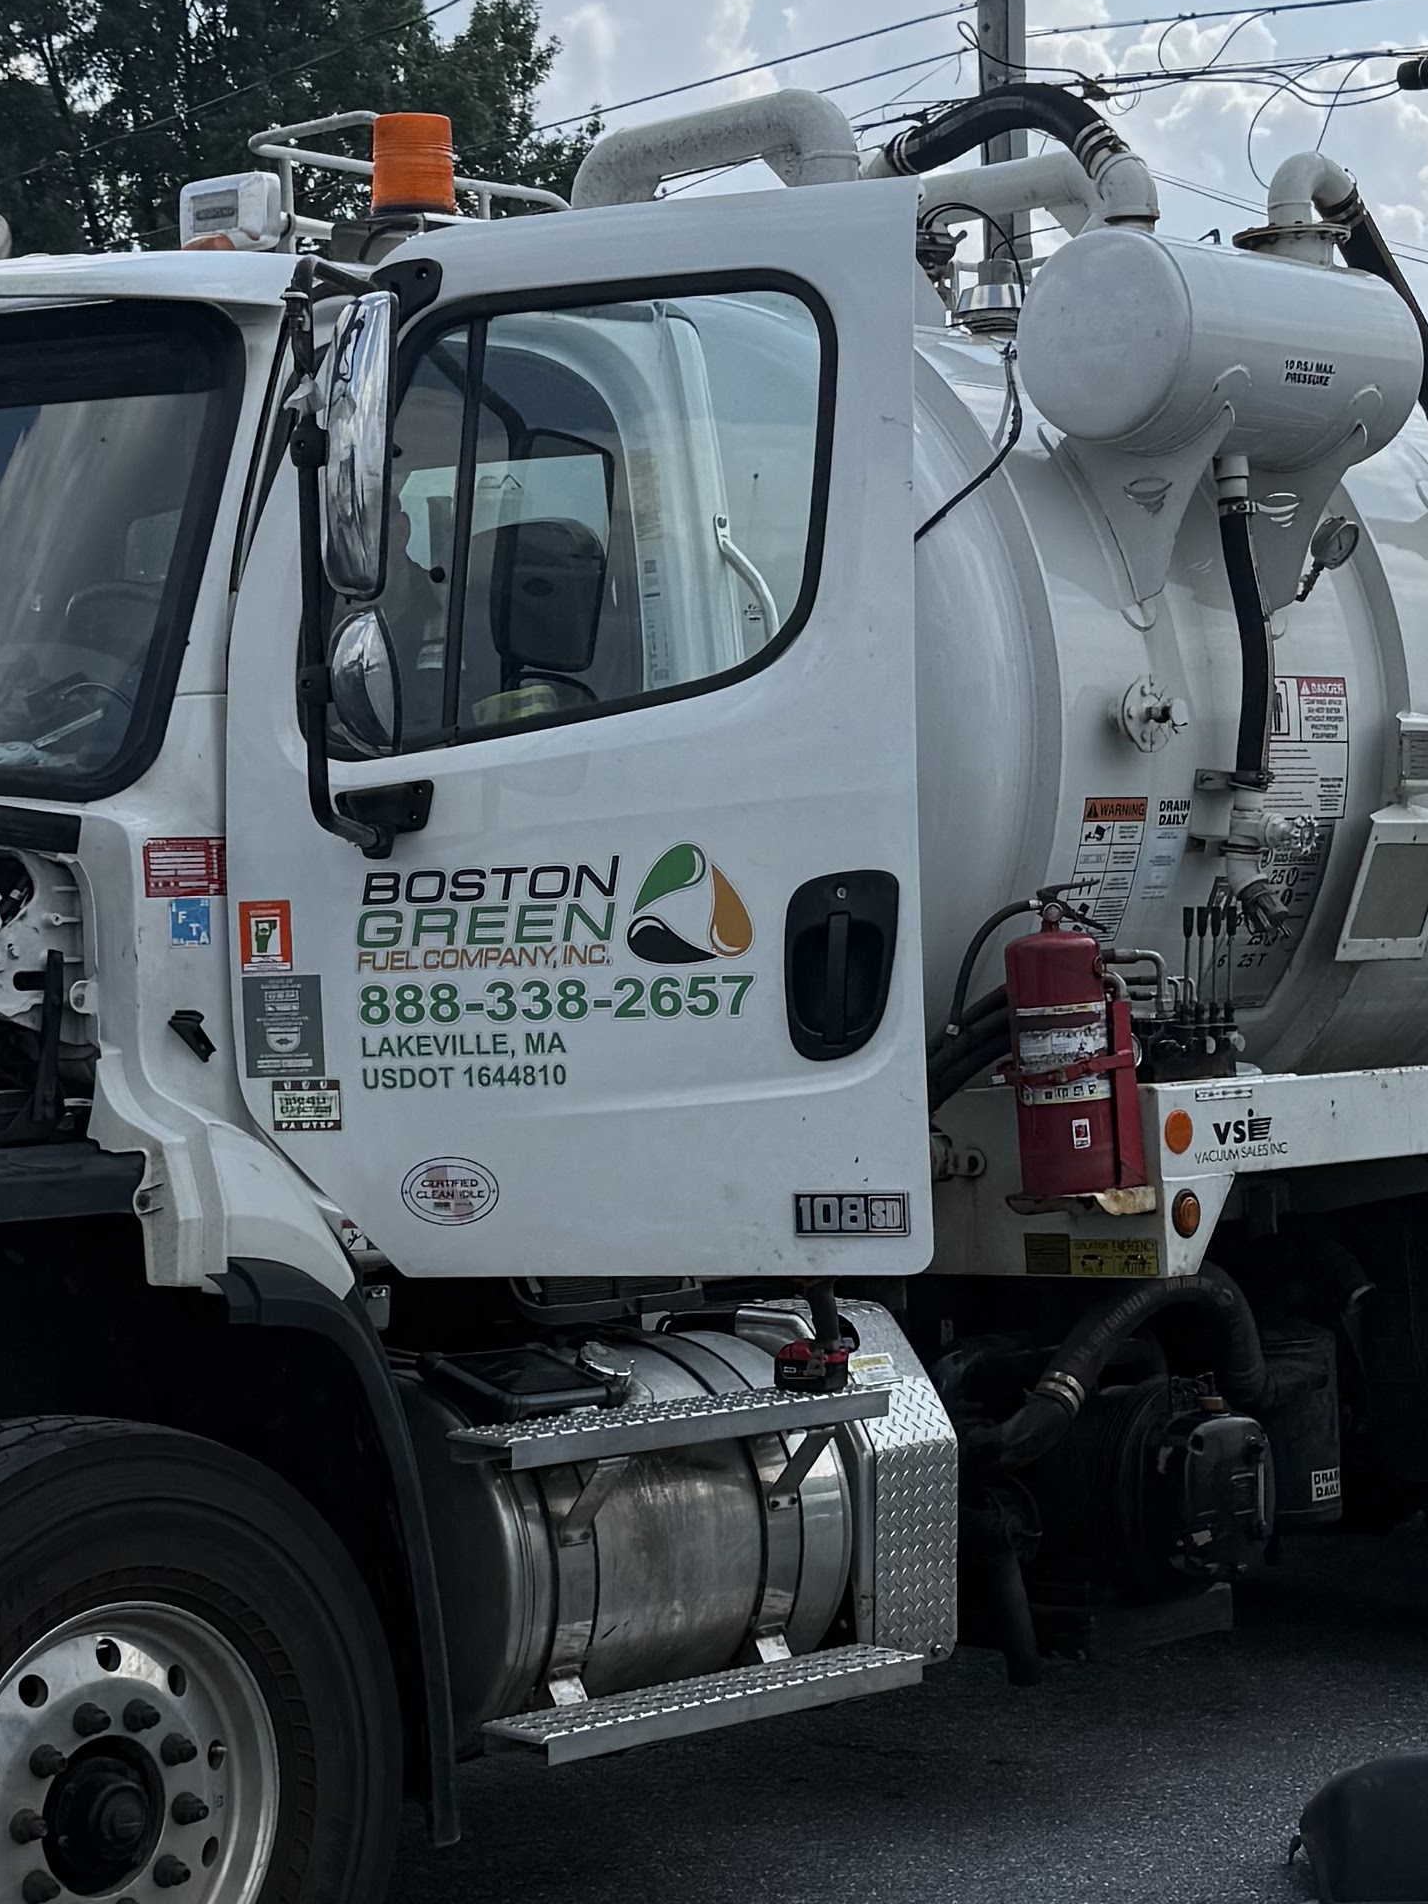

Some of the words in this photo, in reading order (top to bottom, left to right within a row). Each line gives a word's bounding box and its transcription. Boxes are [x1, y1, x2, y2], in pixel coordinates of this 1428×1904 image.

[1285, 372, 1330, 386] PRESSURE
[1311, 683, 1344, 694] DANGER
[1100, 803, 1145, 816] WARNING
[1159, 800, 1191, 812] DRAIN
[1158, 813, 1188, 825] DAILY
[362, 855, 620, 905] BOSTON
[356, 902, 616, 948] GREEN
[358, 950, 419, 972] FUEL
[422, 946, 557, 970] COMPANY,
[563, 944, 612, 966] INC.
[359, 975, 755, 1024] 888-338-2657
[361, 1034, 516, 1058] LAKEVILLE,
[524, 1032, 567, 1054] MA
[362, 1067, 454, 1090] USDOT
[463, 1064, 567, 1087] 1644810
[1195, 1149, 1239, 1164] VACUUM
[1241, 1144, 1268, 1158] SALES
[421, 1179, 478, 1188] CERTIFIED
[416, 1190, 454, 1199] CLEAN
[458, 1190, 485, 1198] IDLE
[799, 1197, 867, 1230] 108
